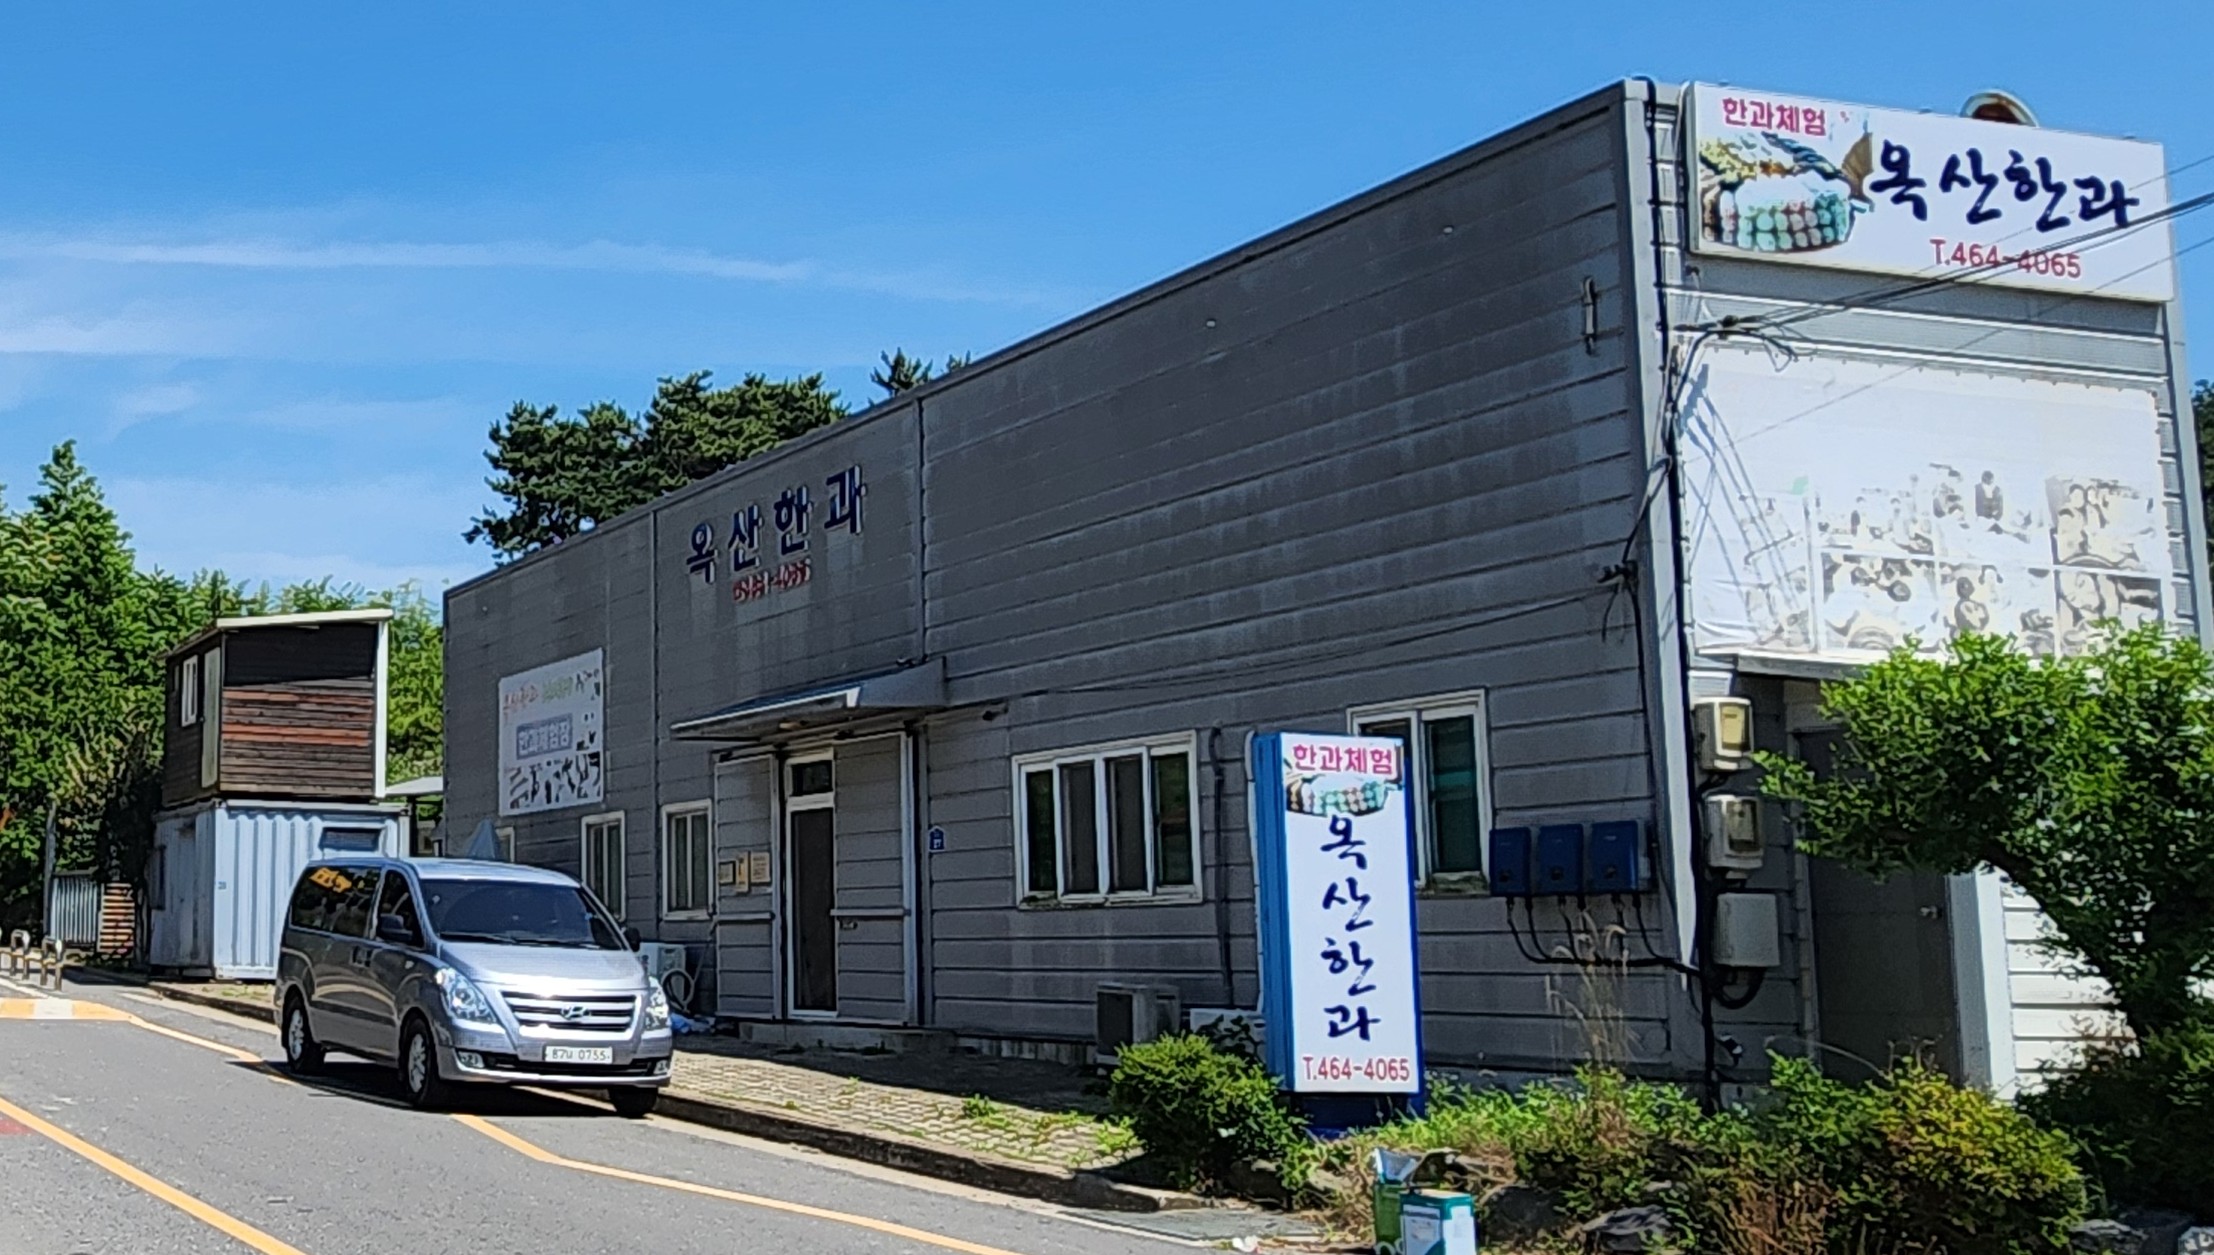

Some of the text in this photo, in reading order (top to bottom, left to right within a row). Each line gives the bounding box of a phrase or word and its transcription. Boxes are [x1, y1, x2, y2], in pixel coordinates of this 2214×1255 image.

[1722, 97, 1827, 137] 한과체험
[1870, 139, 2140, 233] 옥산한과
[1929, 239, 2081, 278] T.464-4065
[686, 464, 867, 583] 옥산한과
[1292, 743, 1393, 775] 한과체험
[1319, 814, 1381, 1042] 옥산한과
[1302, 1056, 1410, 1082] T.464-4065
